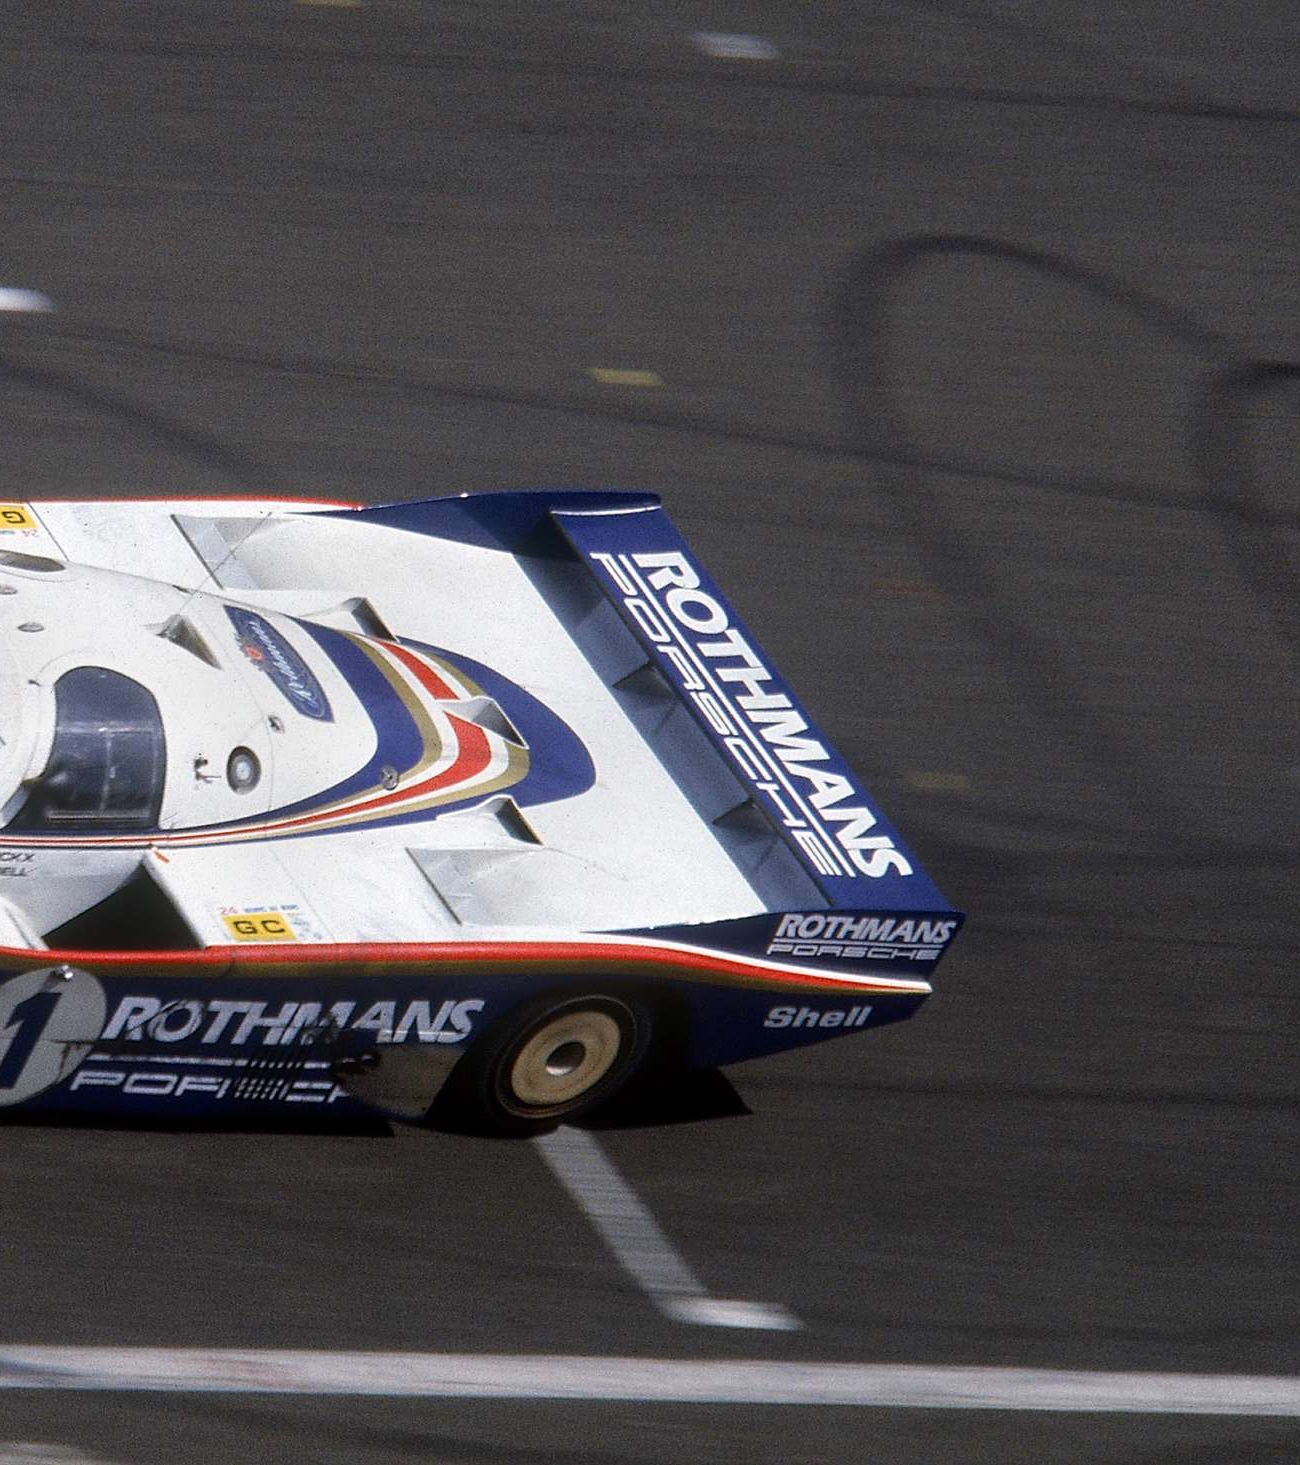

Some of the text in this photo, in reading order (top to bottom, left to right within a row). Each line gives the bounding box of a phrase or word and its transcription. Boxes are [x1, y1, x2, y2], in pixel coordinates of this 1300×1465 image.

[589, 551, 843, 876] PORSCHE
[632, 550, 913, 878] ROTHMANS
[776, 913, 956, 943] ROTHMANS
[766, 943, 940, 960] PORSCHE
[101, 996, 486, 1046] ROTHMANS
[764, 1005, 873, 1029] Shell
[70, 1070, 351, 1104] PORC
